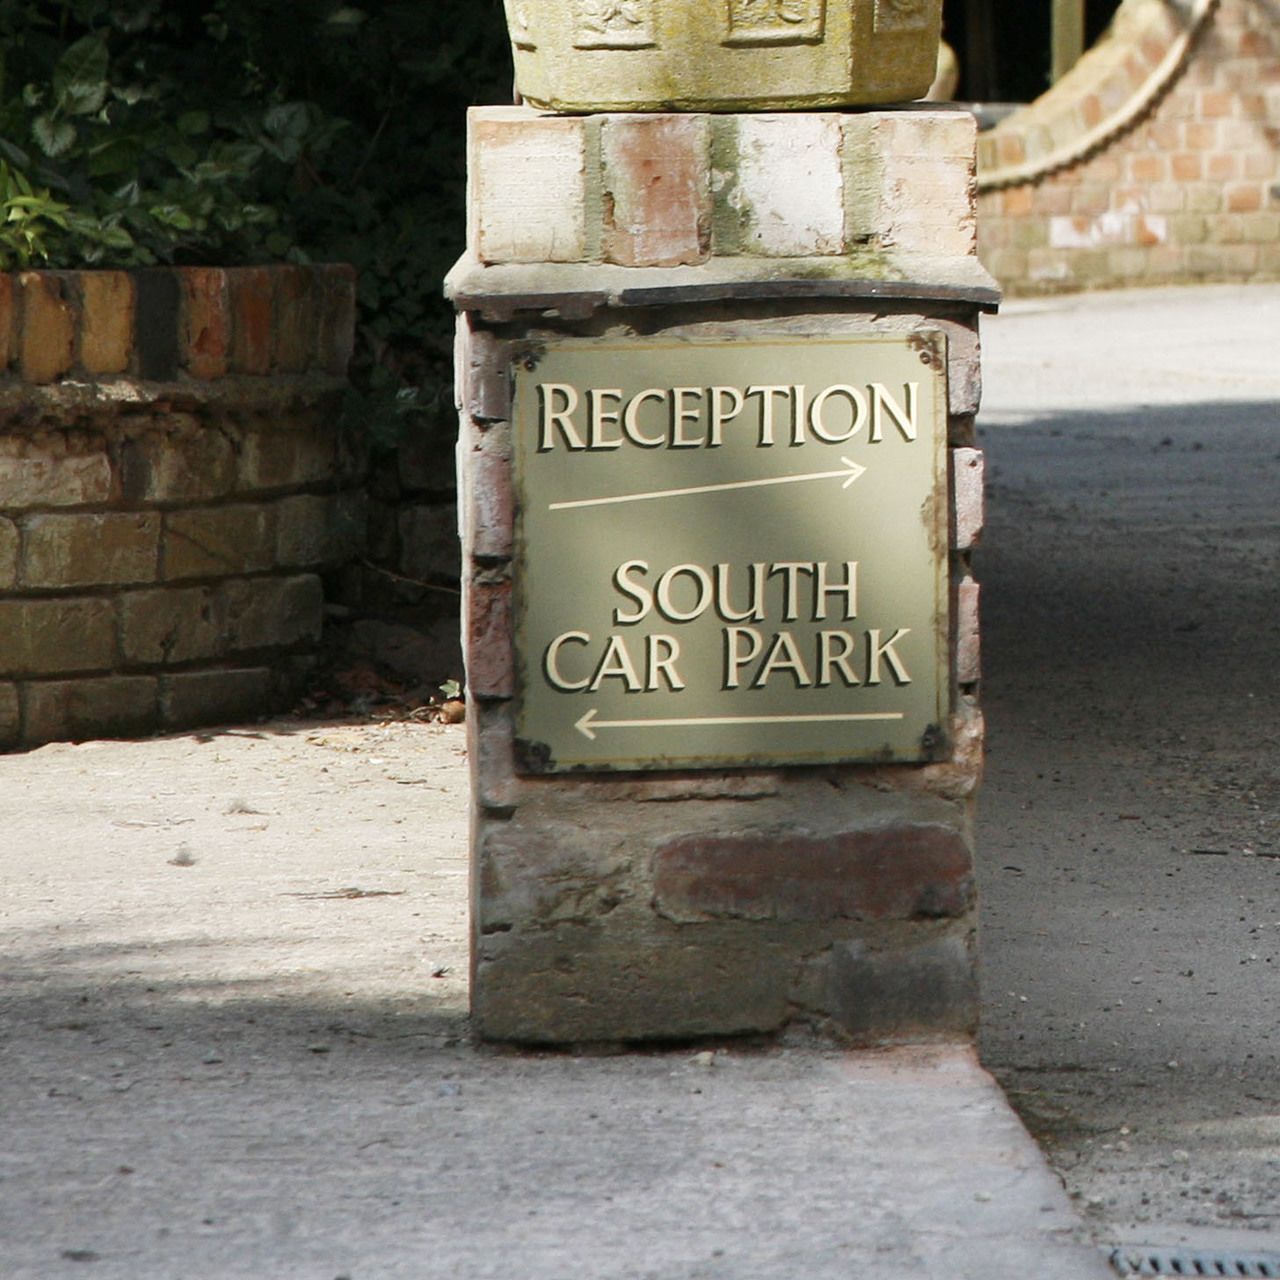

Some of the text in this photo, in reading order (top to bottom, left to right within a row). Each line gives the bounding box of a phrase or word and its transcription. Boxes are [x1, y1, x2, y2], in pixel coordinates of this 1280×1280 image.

[538, 382, 919, 452] RECEPTION
[612, 559, 860, 623] SOUTH
[544, 627, 912, 693] CAR PARK
